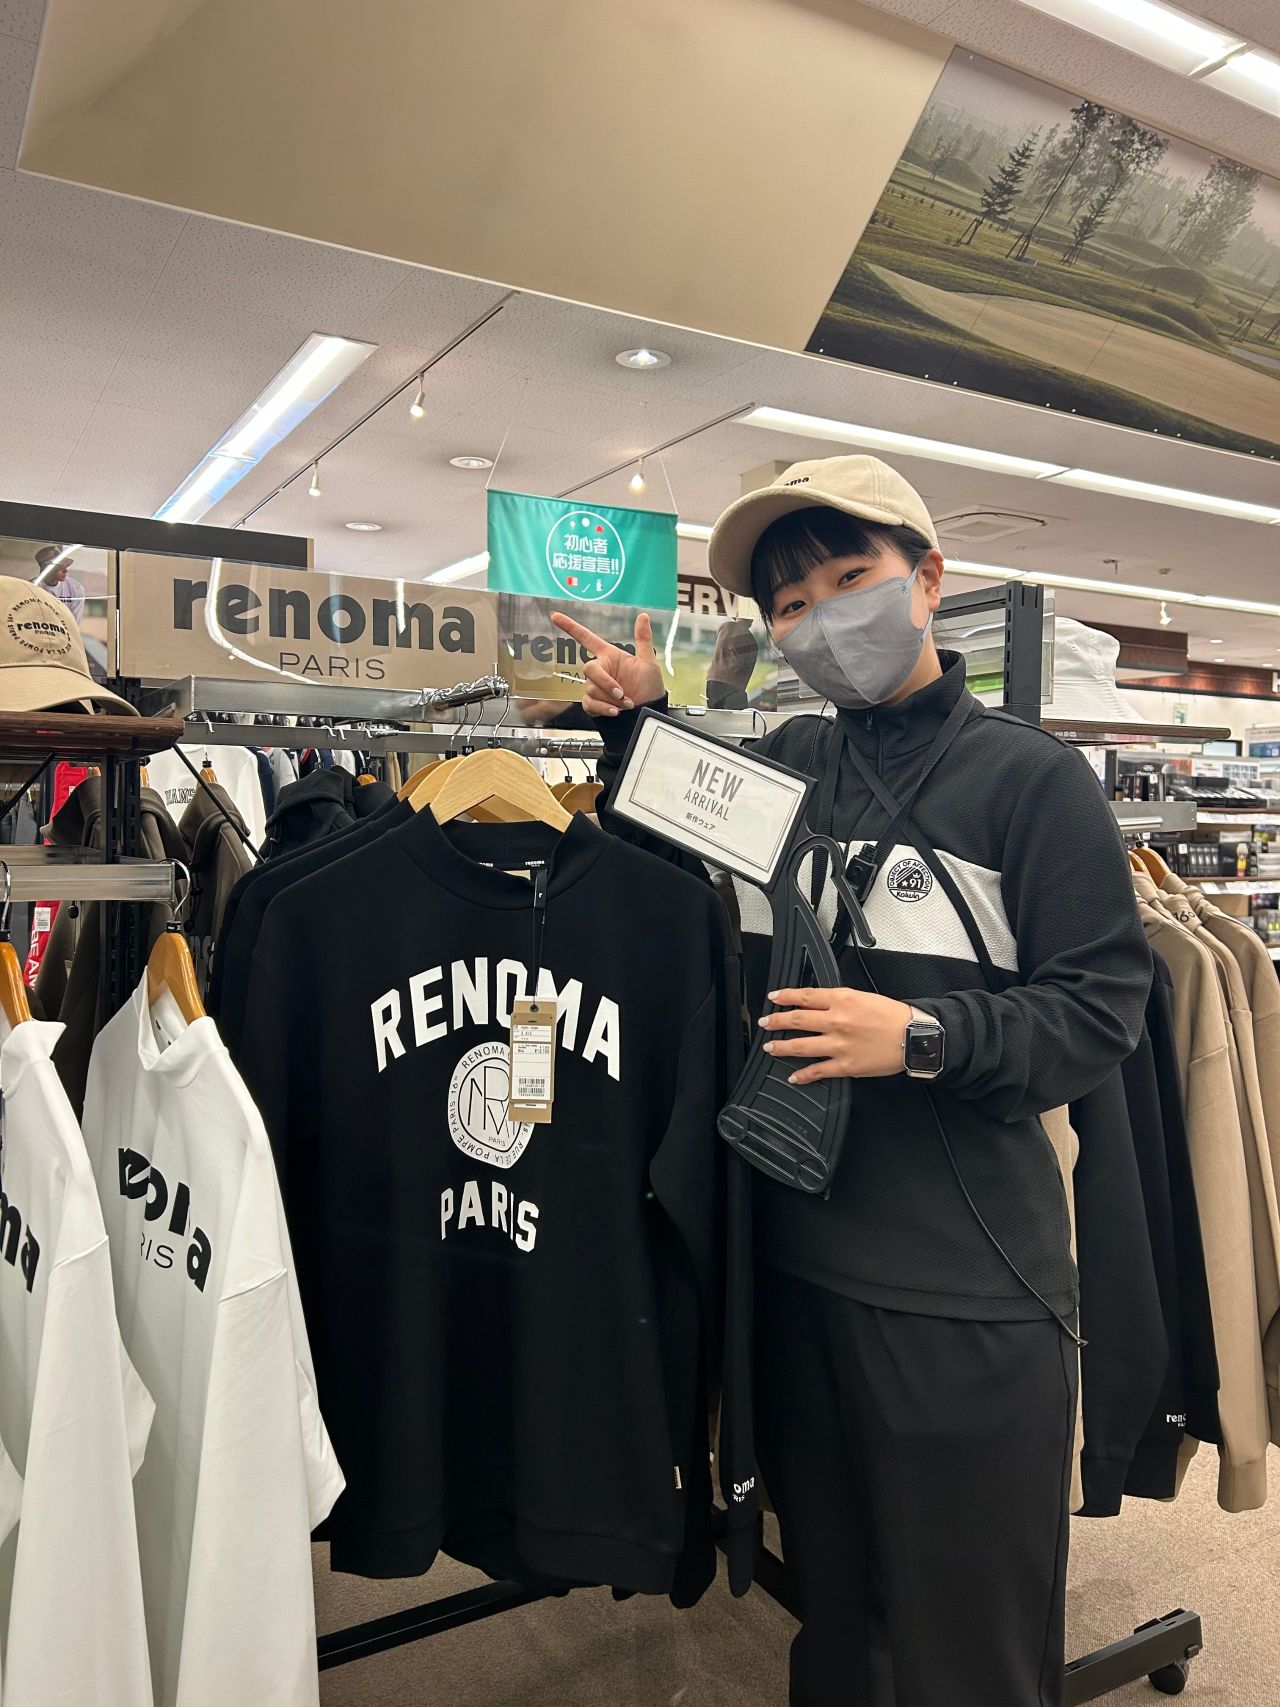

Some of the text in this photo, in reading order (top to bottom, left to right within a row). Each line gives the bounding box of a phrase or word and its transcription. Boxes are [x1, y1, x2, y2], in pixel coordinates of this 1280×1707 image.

[564, 534, 608, 555] 初心者
[552, 552, 620, 576] 応援宣言!!
[16, 621, 66, 635] renoma
[173, 578, 476, 654] renoma
[279, 652, 386, 681] PARIS
[690, 758, 744, 803] NEW
[683, 788, 730, 822] ARRIVAL
[685, 811, 717, 832] 新作ウェア
[889, 864, 903, 887] OBJECT
[912, 861, 931, 890] AFFECTION
[909, 878, 922, 889] 91
[370, 956, 620, 1082] RENOMA
[461, 1045, 505, 1069] RENOMA
[449, 1100, 460, 1134] PARIS
[456, 1134, 491, 1160] POMPE
[488, 1136, 507, 1147] PARIS
[440, 1180, 540, 1253] PARIS
